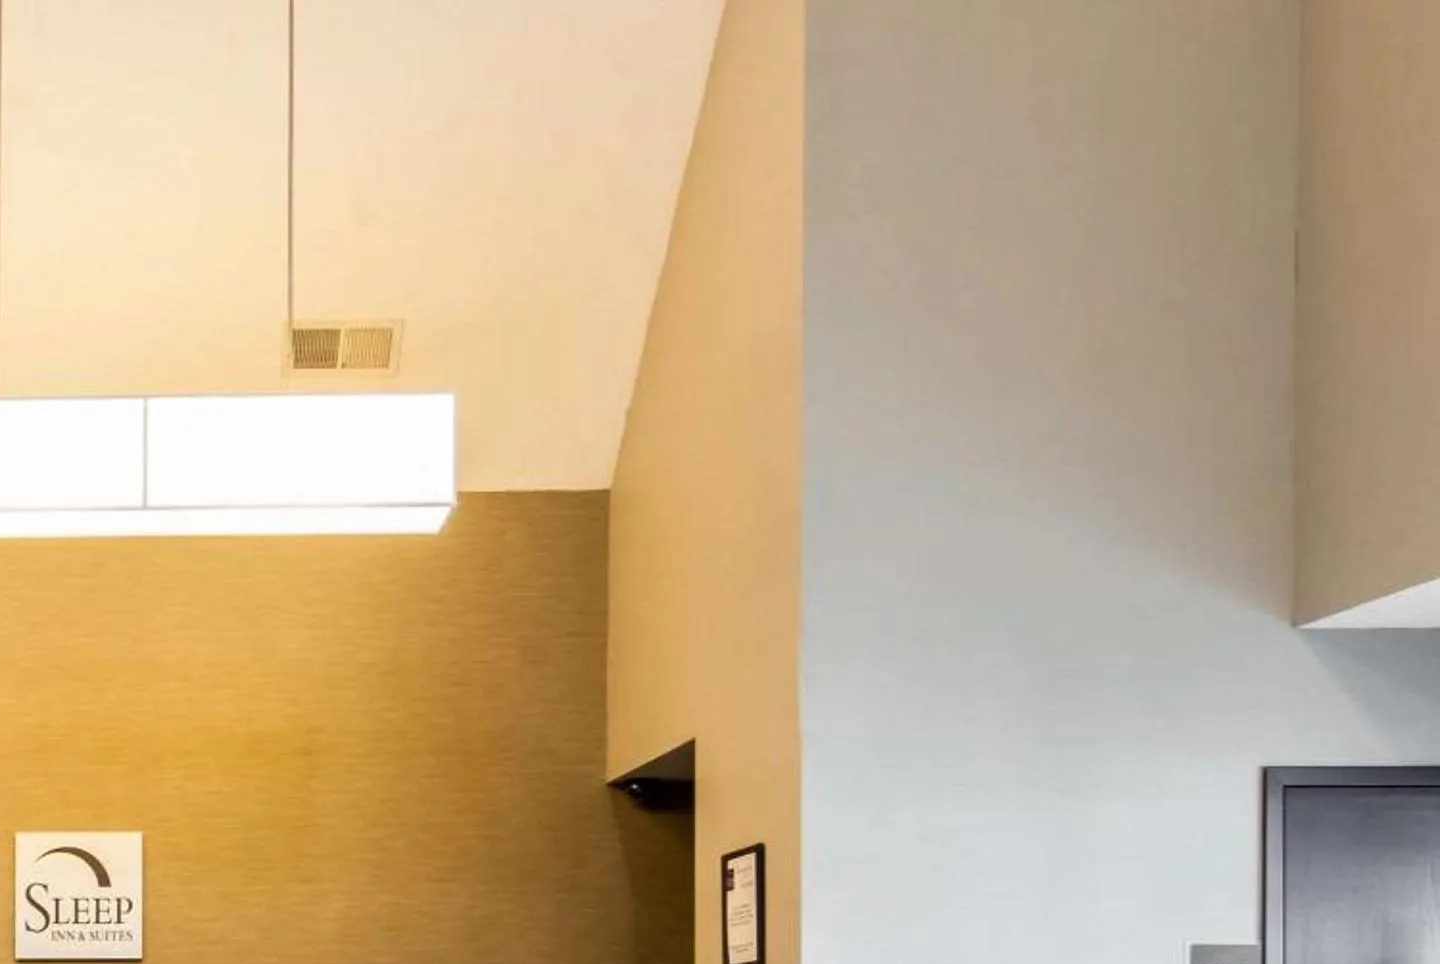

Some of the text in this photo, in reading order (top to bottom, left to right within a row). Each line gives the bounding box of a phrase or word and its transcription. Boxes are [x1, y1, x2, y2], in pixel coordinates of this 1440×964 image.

[24, 882, 134, 933] SLEEP
[51, 930, 75, 941] INN
[89, 930, 134, 941] SUITES
